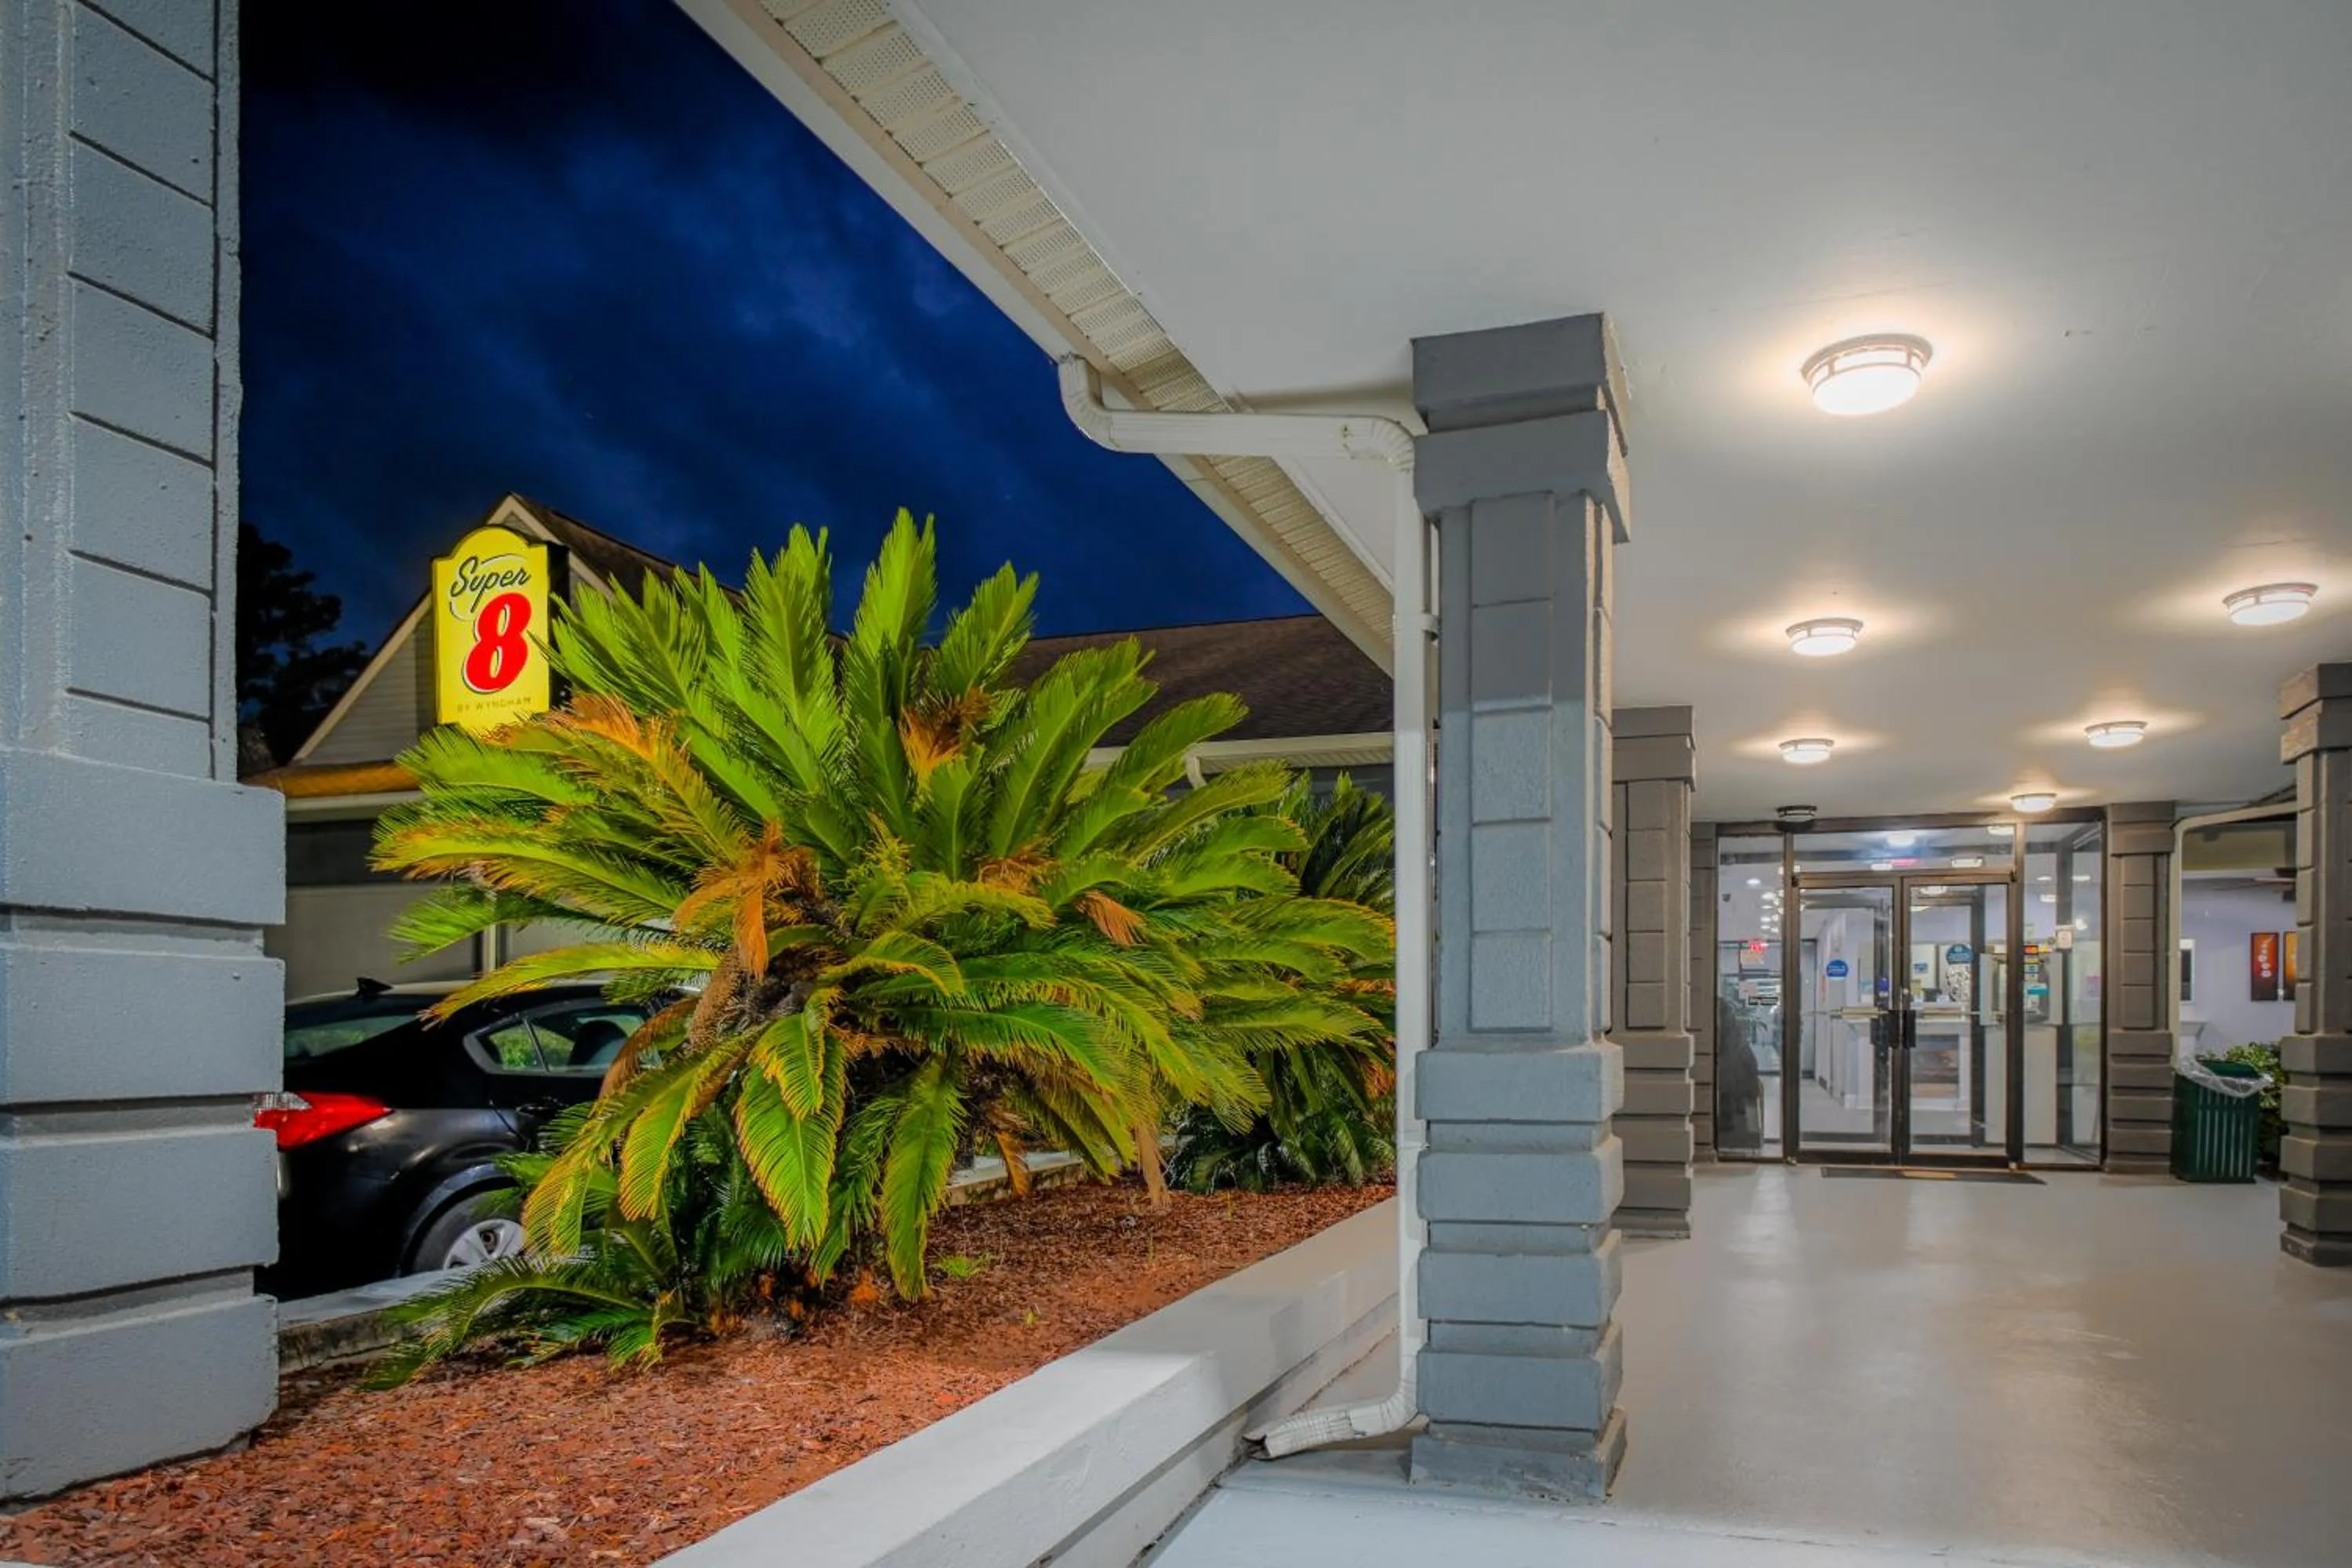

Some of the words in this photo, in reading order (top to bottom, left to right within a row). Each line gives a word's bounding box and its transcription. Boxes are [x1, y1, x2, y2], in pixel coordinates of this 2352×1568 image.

[450, 555, 532, 614] Super
[461, 592, 532, 694] 8
[475, 697, 532, 710] WYNDHAM
